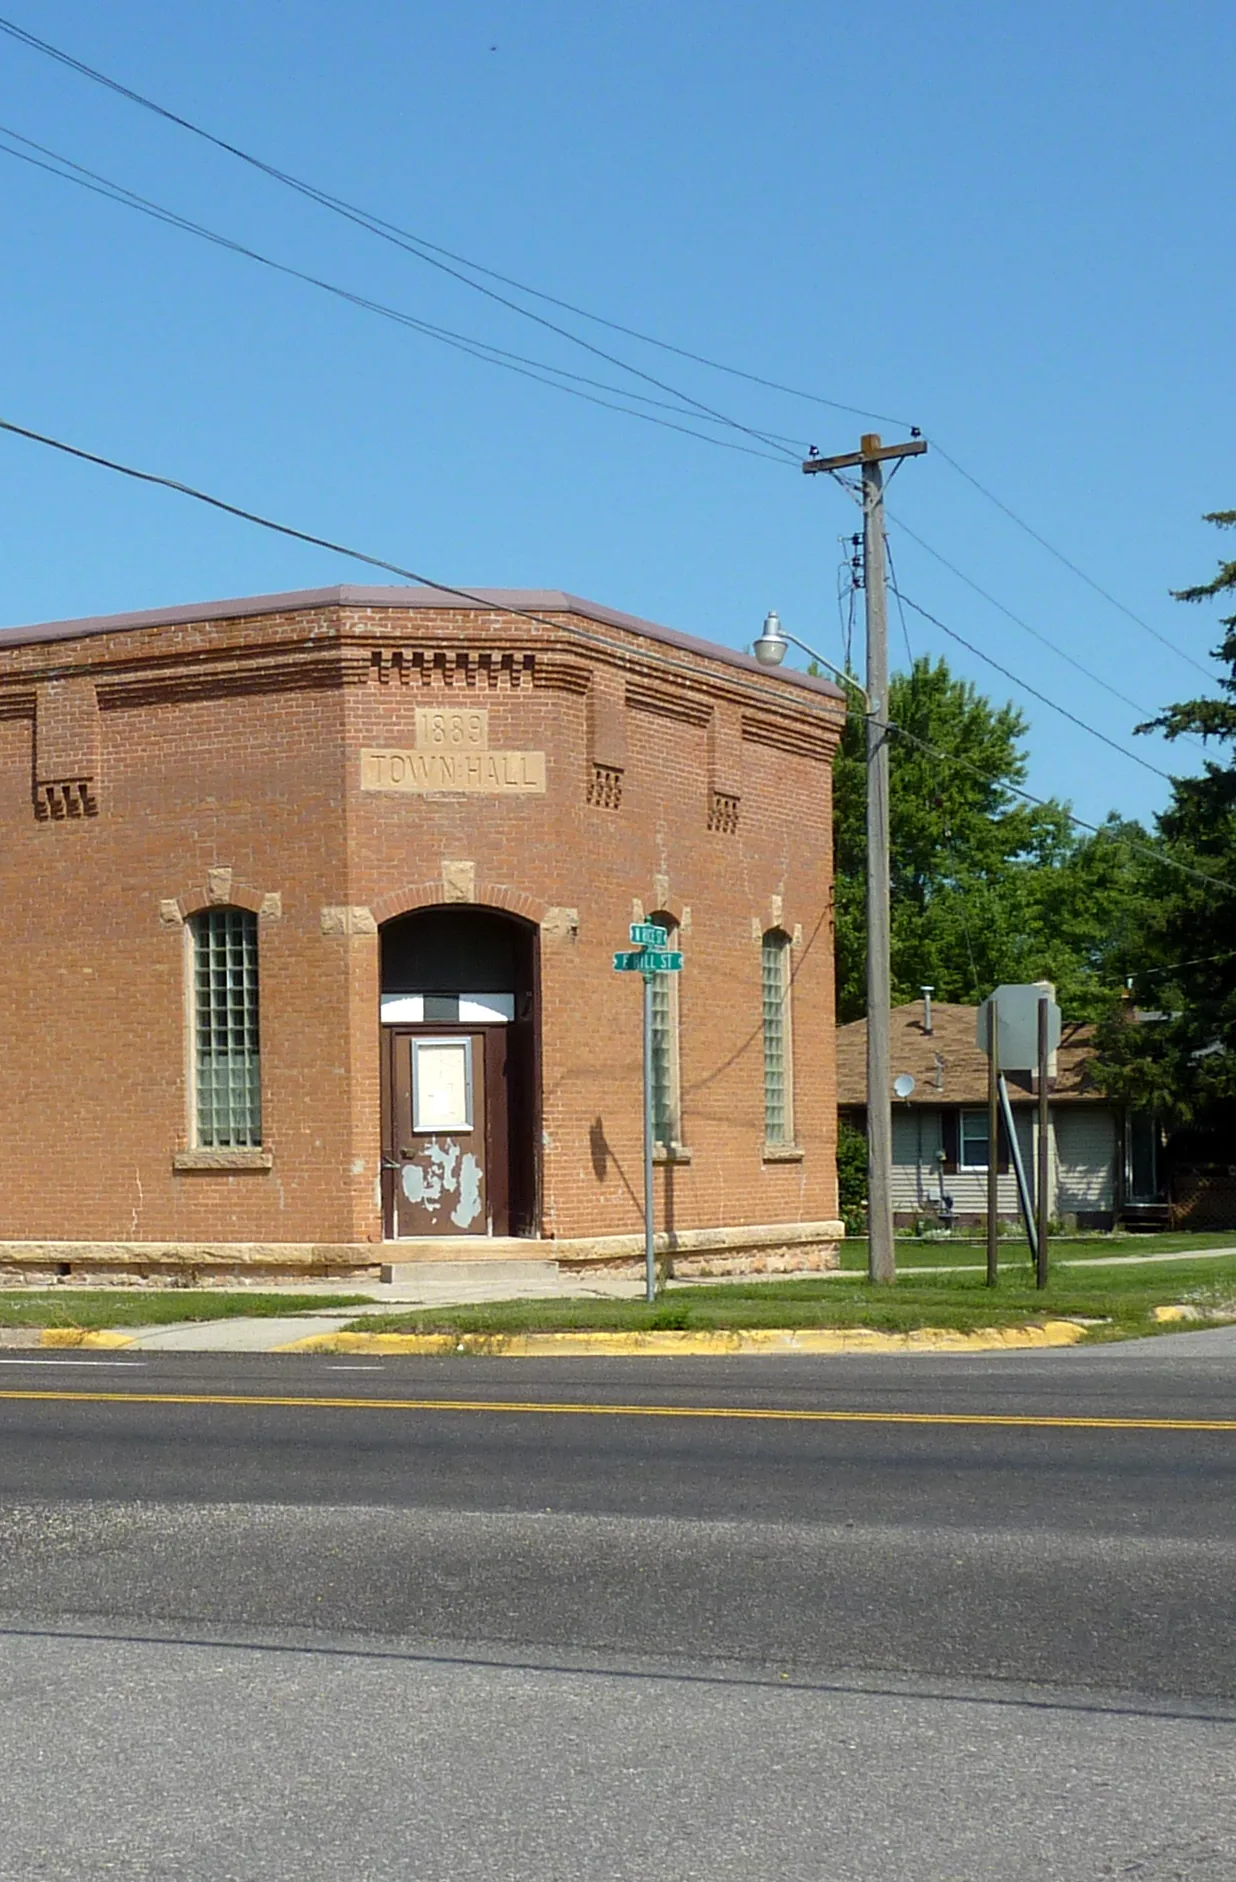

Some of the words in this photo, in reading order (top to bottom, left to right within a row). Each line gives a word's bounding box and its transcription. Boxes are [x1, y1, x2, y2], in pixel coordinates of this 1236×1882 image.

[370, 754, 456, 786] TOWN
[465, 755, 538, 787] HALL
[660, 954, 674, 969] ST
